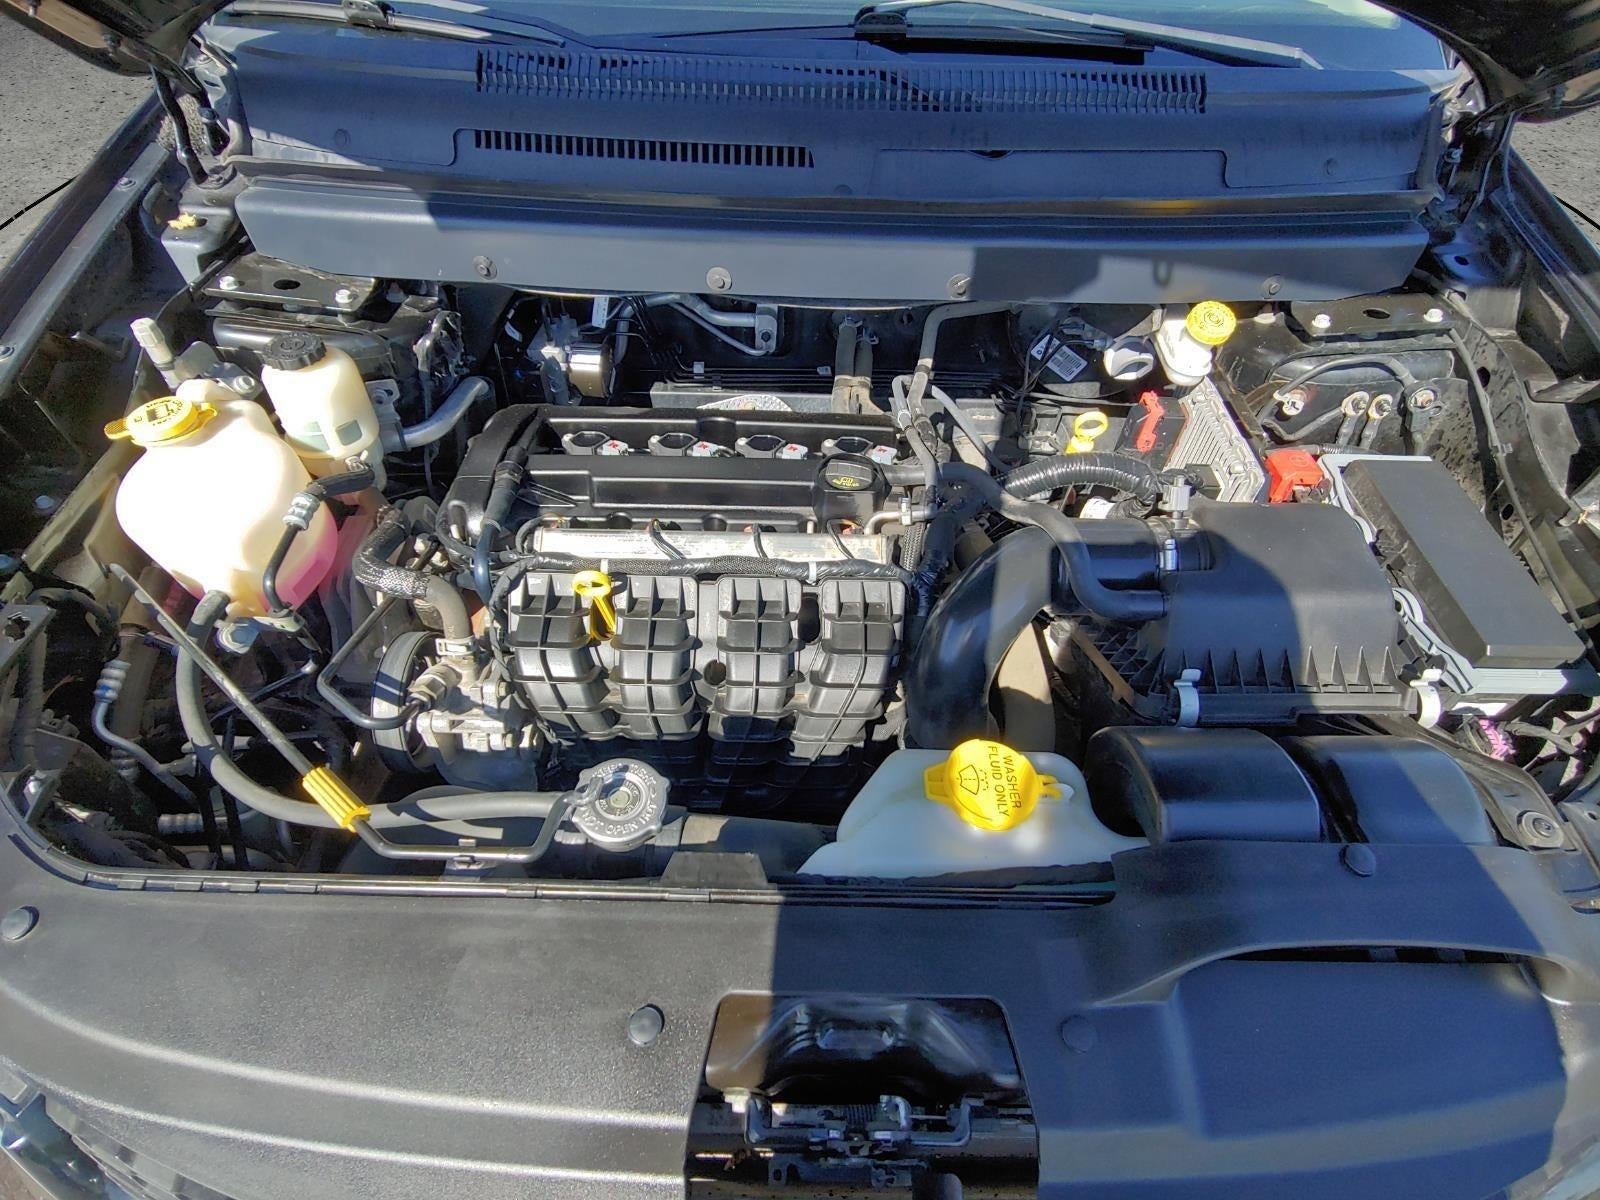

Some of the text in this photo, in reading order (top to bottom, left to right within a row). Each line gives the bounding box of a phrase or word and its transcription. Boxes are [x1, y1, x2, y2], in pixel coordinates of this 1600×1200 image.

[987, 745, 1010, 817] FLUID ONLY
[1002, 755, 1022, 809] WASHER
[605, 822, 639, 836] OPEN
